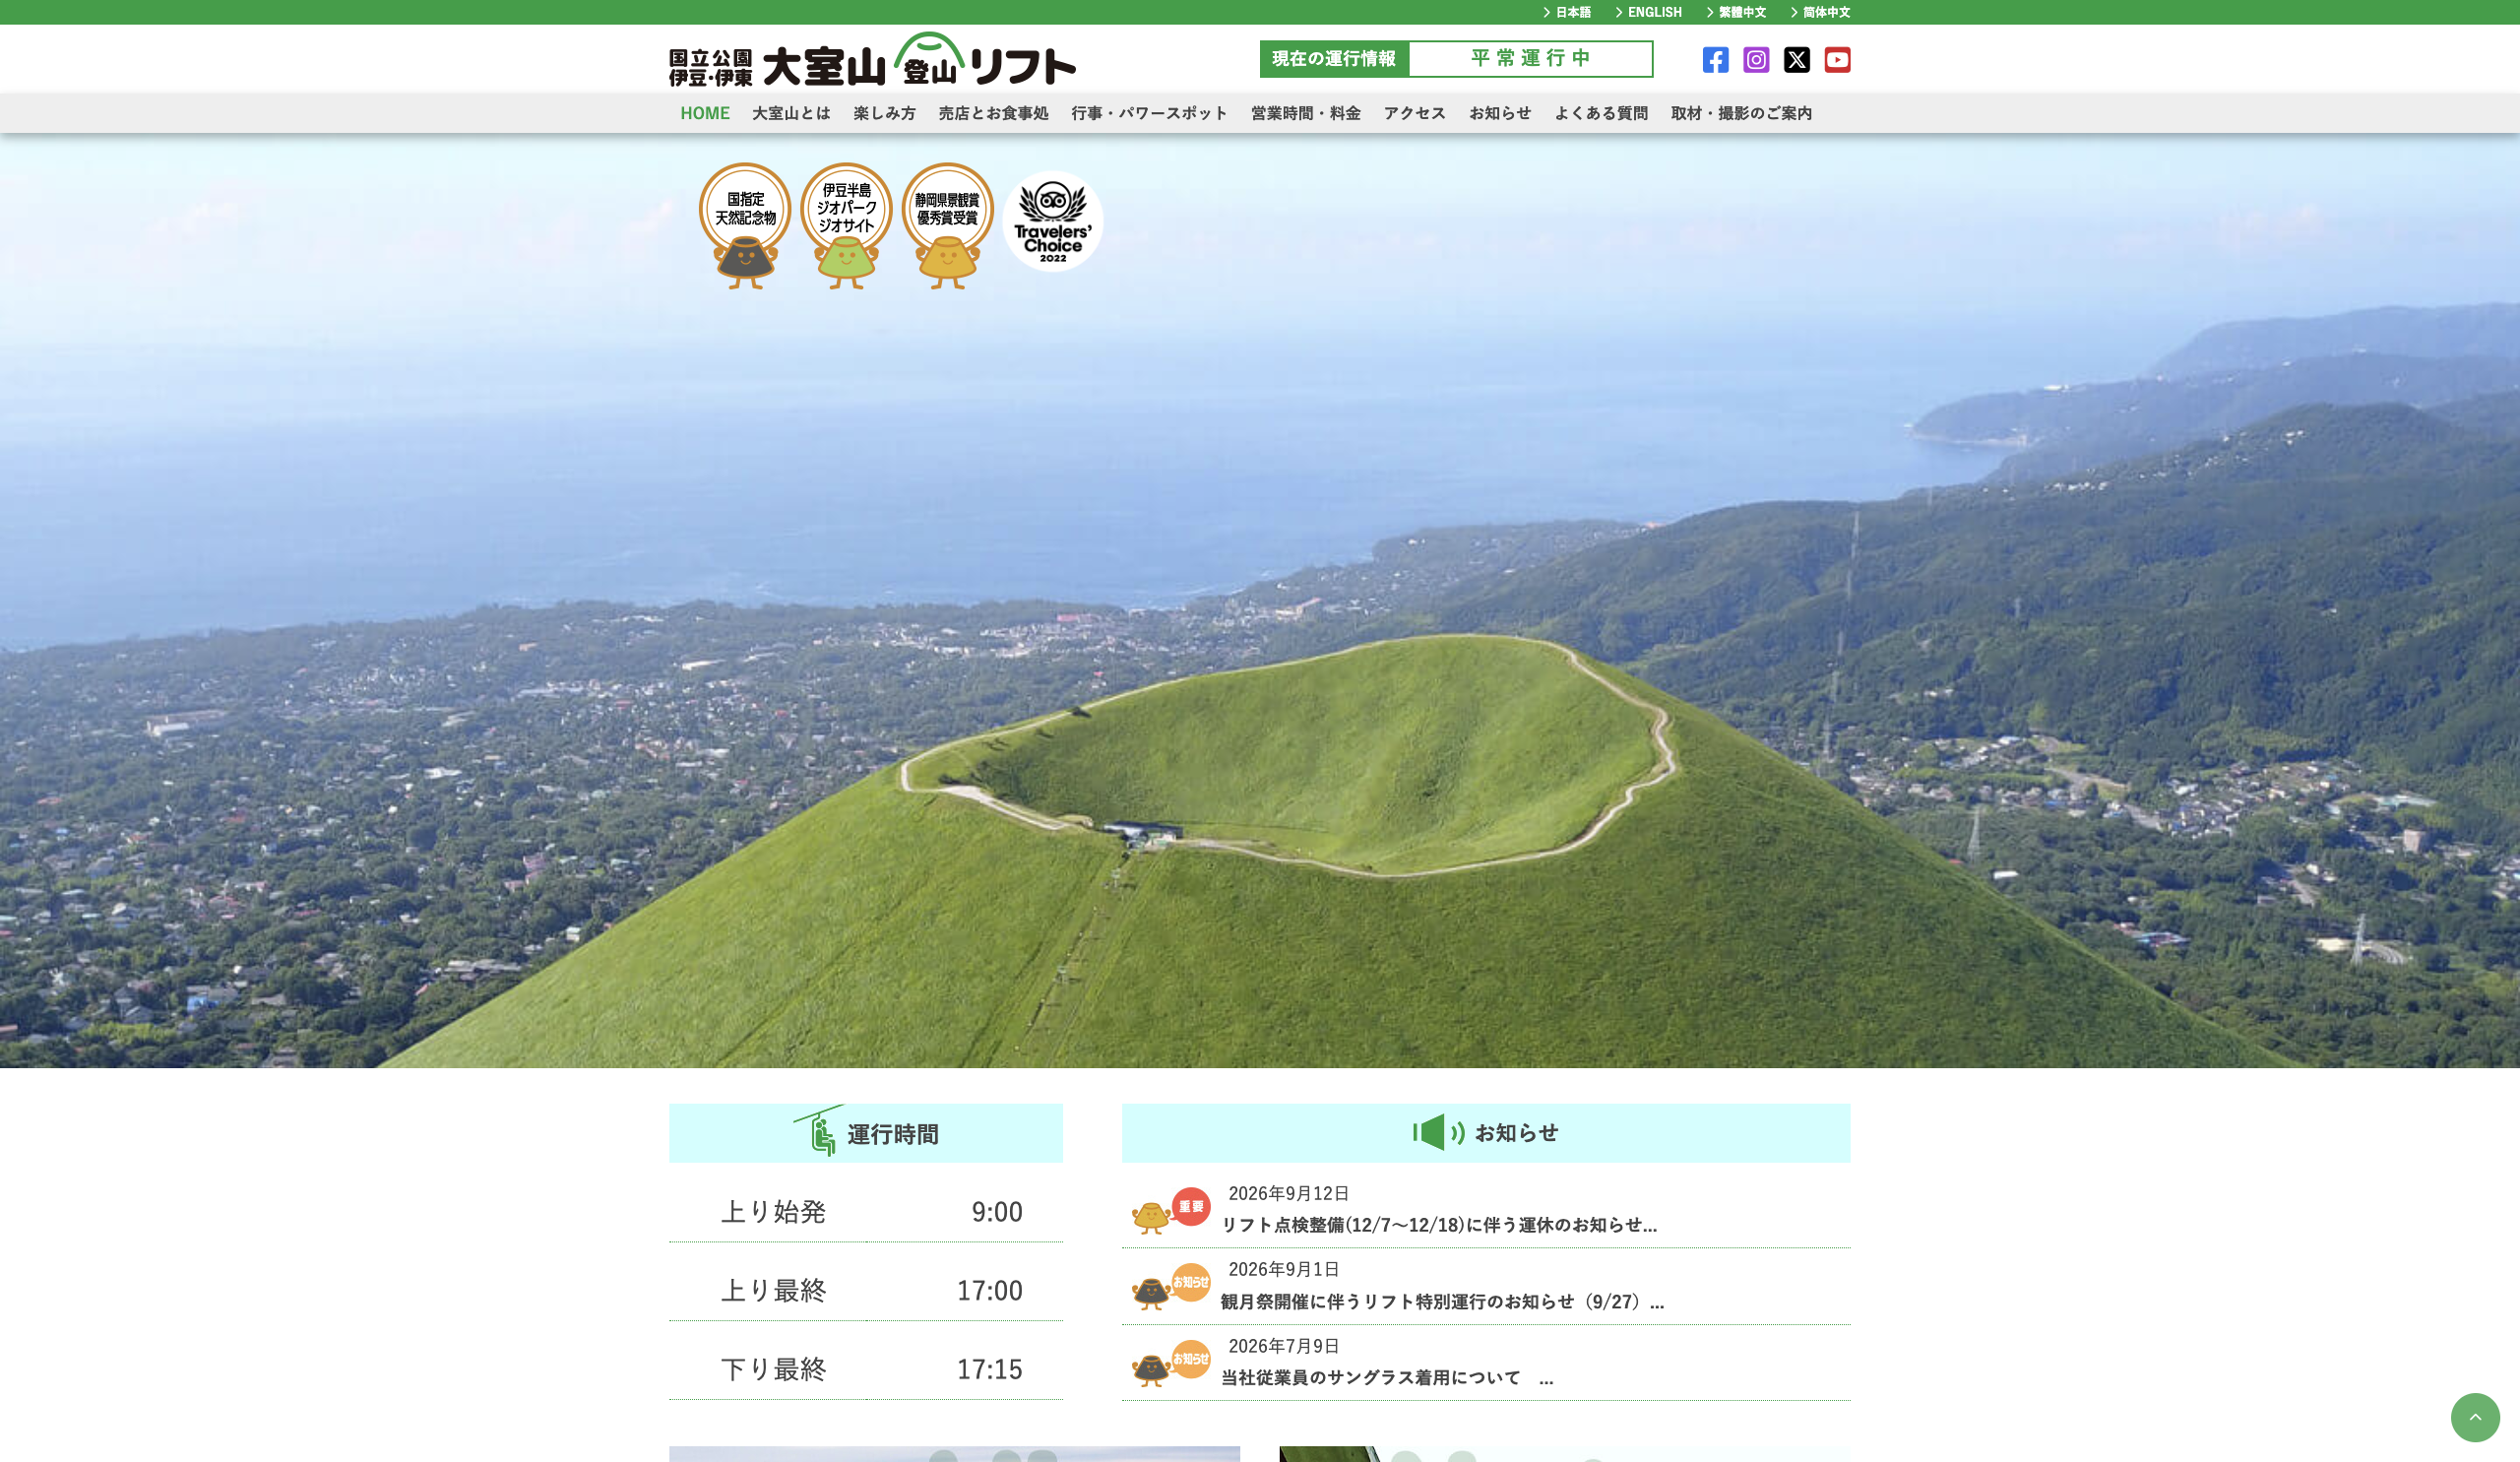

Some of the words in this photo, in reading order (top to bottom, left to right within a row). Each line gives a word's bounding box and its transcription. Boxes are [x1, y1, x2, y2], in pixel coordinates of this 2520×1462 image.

[1557, 6, 1591, 18] 日本語
[1629, 7, 1681, 17] ENGLISH
[1720, 6, 1766, 18] 繁體中文
[1803, 6, 1851, 18] 简体中文
[669, 49, 752, 67] 国立公園
[1272, 50, 1396, 67] 現在の運行情報
[681, 106, 729, 119] HOME
[753, 105, 830, 120] 大室山とは
[854, 105, 915, 120] 楽しみ方
[939, 105, 1048, 120] 売店とお食事処
[1072, 105, 1226, 120] 行事・パワースポット
[1252, 105, 1361, 120] 営業時間・料金
[1385, 106, 1445, 120] アクセス
[1470, 105, 1532, 120] お知らせ
[1556, 105, 1648, 121] よくある質問
[1671, 105, 1811, 120] 取材・撮影のご案内
[823, 183, 871, 199] 伊豆半島
[728, 191, 765, 207] 国指定
[915, 193, 979, 208] 静岡県景観賞
[818, 200, 876, 215] ジオパーク
[716, 210, 776, 225] 天然記念物
[917, 211, 978, 225] 優秀賞受賞
[819, 219, 875, 233] ジオサイト
[1024, 239, 1083, 253] Choice
[849, 1123, 938, 1145] 運行時間
[1476, 1123, 1558, 1142] お知らせ
[1229, 1185, 1348, 1202] 2026年9月12日
[722, 1199, 826, 1224] 上り始発
[973, 1201, 1022, 1222] 9:00
[1179, 1200, 1203, 1212] 重要
[1229, 1261, 1338, 1278] 2026年9月1日
[1173, 1276, 1210, 1289] お知らせ
[722, 1278, 826, 1303] 上り最終
[959, 1280, 1022, 1301] 17:00
[1229, 1338, 1338, 1355] 2026年7月9日
[1173, 1353, 1210, 1366] お知らせ
[722, 1357, 826, 1381] 下り最終
[959, 1359, 1022, 1379] 17:15
